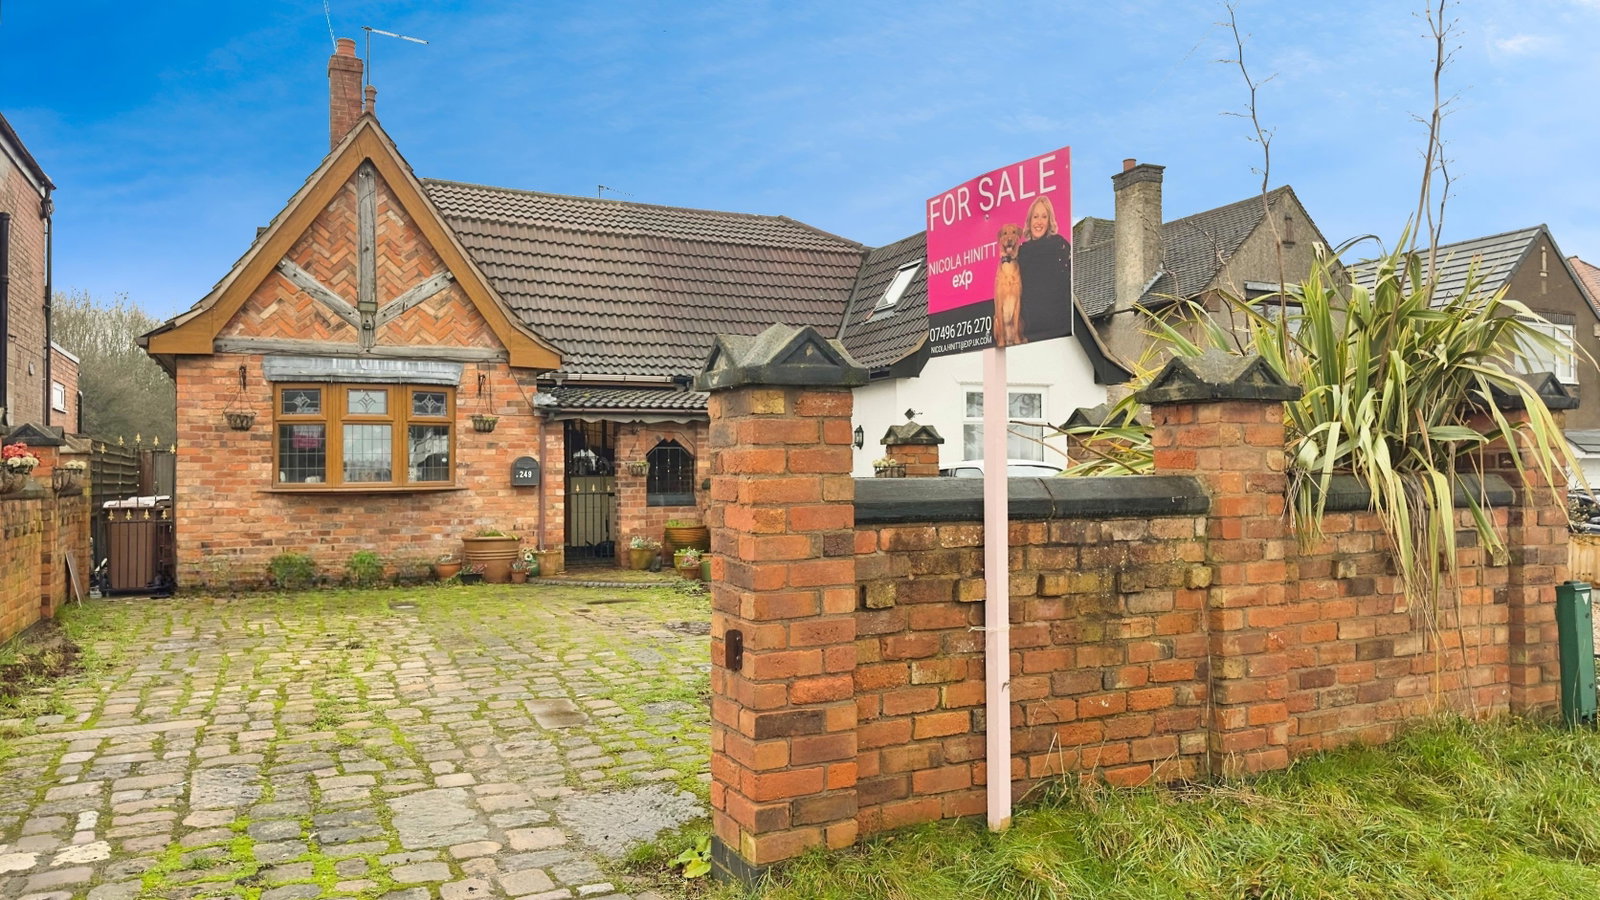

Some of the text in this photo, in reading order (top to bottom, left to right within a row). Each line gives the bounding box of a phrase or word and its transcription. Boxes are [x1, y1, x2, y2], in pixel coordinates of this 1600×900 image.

[930, 154, 1057, 232] FOR SALE
[928, 241, 998, 276] NICOLA HINITT
[952, 269, 973, 290] exp
[929, 316, 992, 342] 07496 276 270
